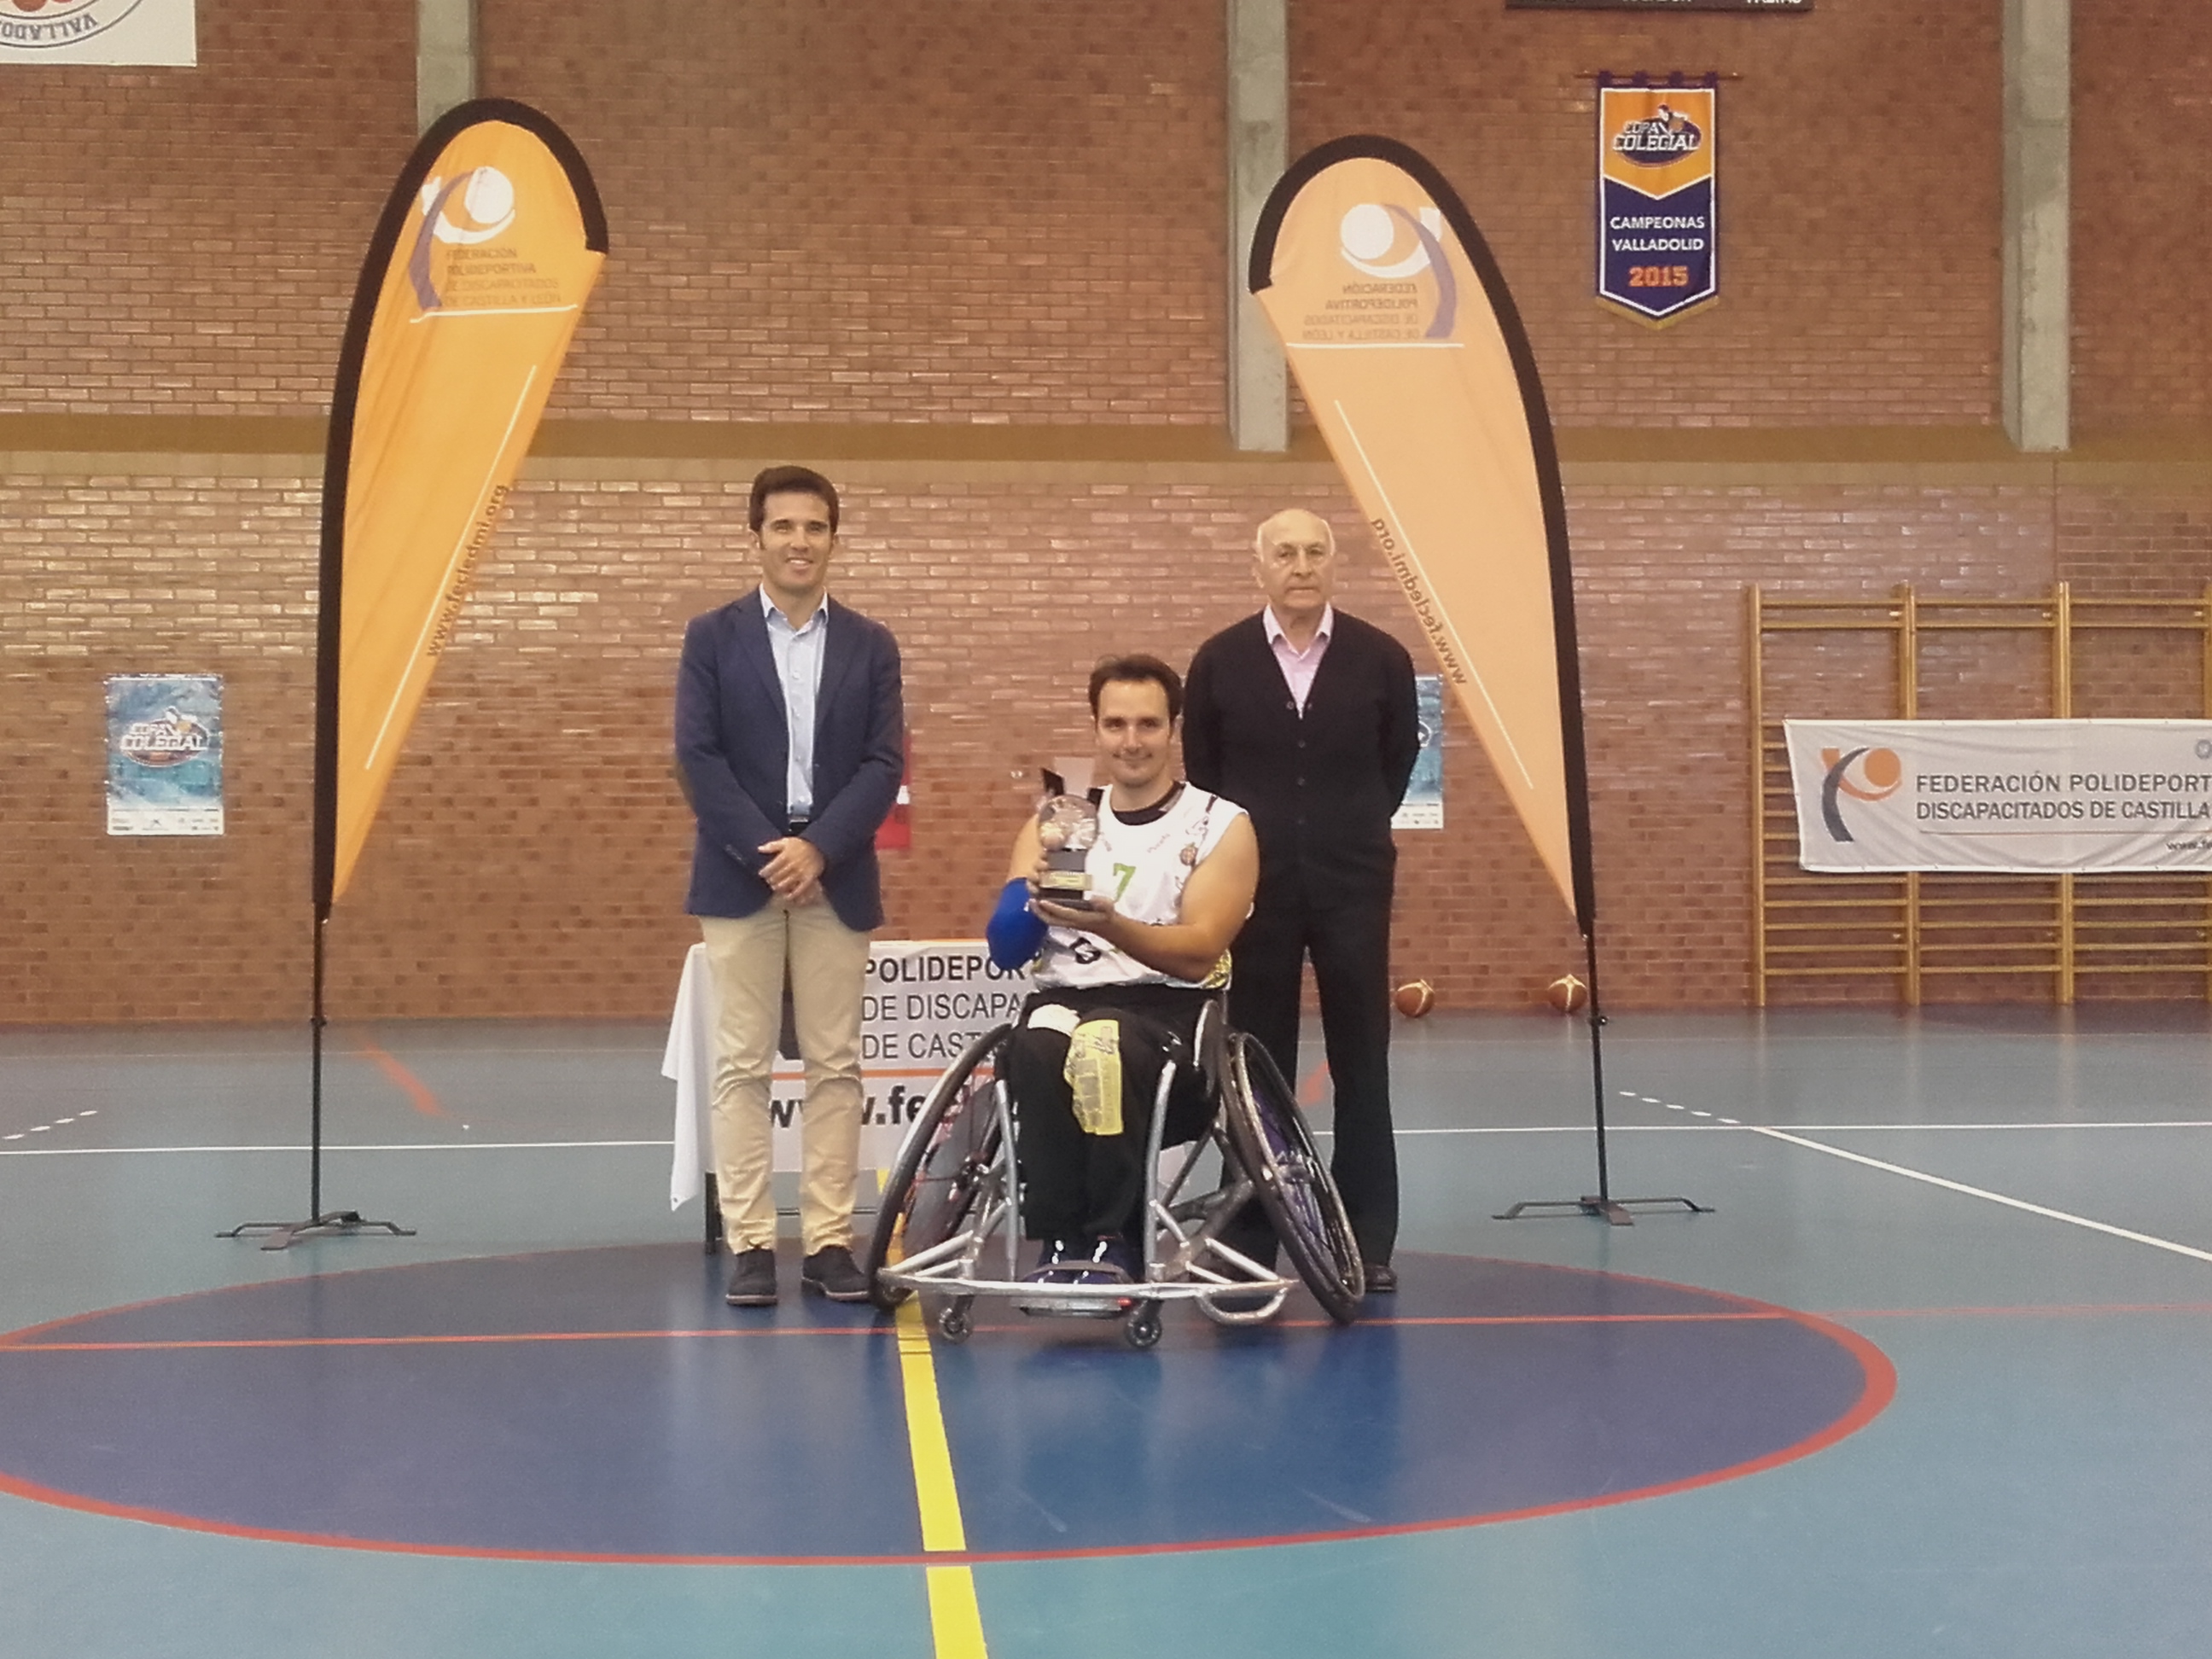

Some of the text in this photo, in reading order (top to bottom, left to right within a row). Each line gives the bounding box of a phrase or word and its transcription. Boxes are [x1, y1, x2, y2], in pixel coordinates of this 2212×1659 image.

[0, 13, 97, 40] VALLADO
[1625, 121, 1659, 134] COPA
[1612, 134, 1700, 150] COLEGIAL
[1610, 217, 1705, 229] CAMPEONAS
[1612, 238, 1704, 251] VALLADOLID
[1629, 265, 1688, 287] 2015
[1916, 771, 2212, 793] FEDERACIÓN POLIDEPORT
[1916, 800, 2211, 820] DISCAPACITADOS DE CASTILLA
[1113, 862, 1137, 902] 7
[862, 992, 1022, 1021] DE DISCAPA
[862, 1033, 899, 1059] DE
